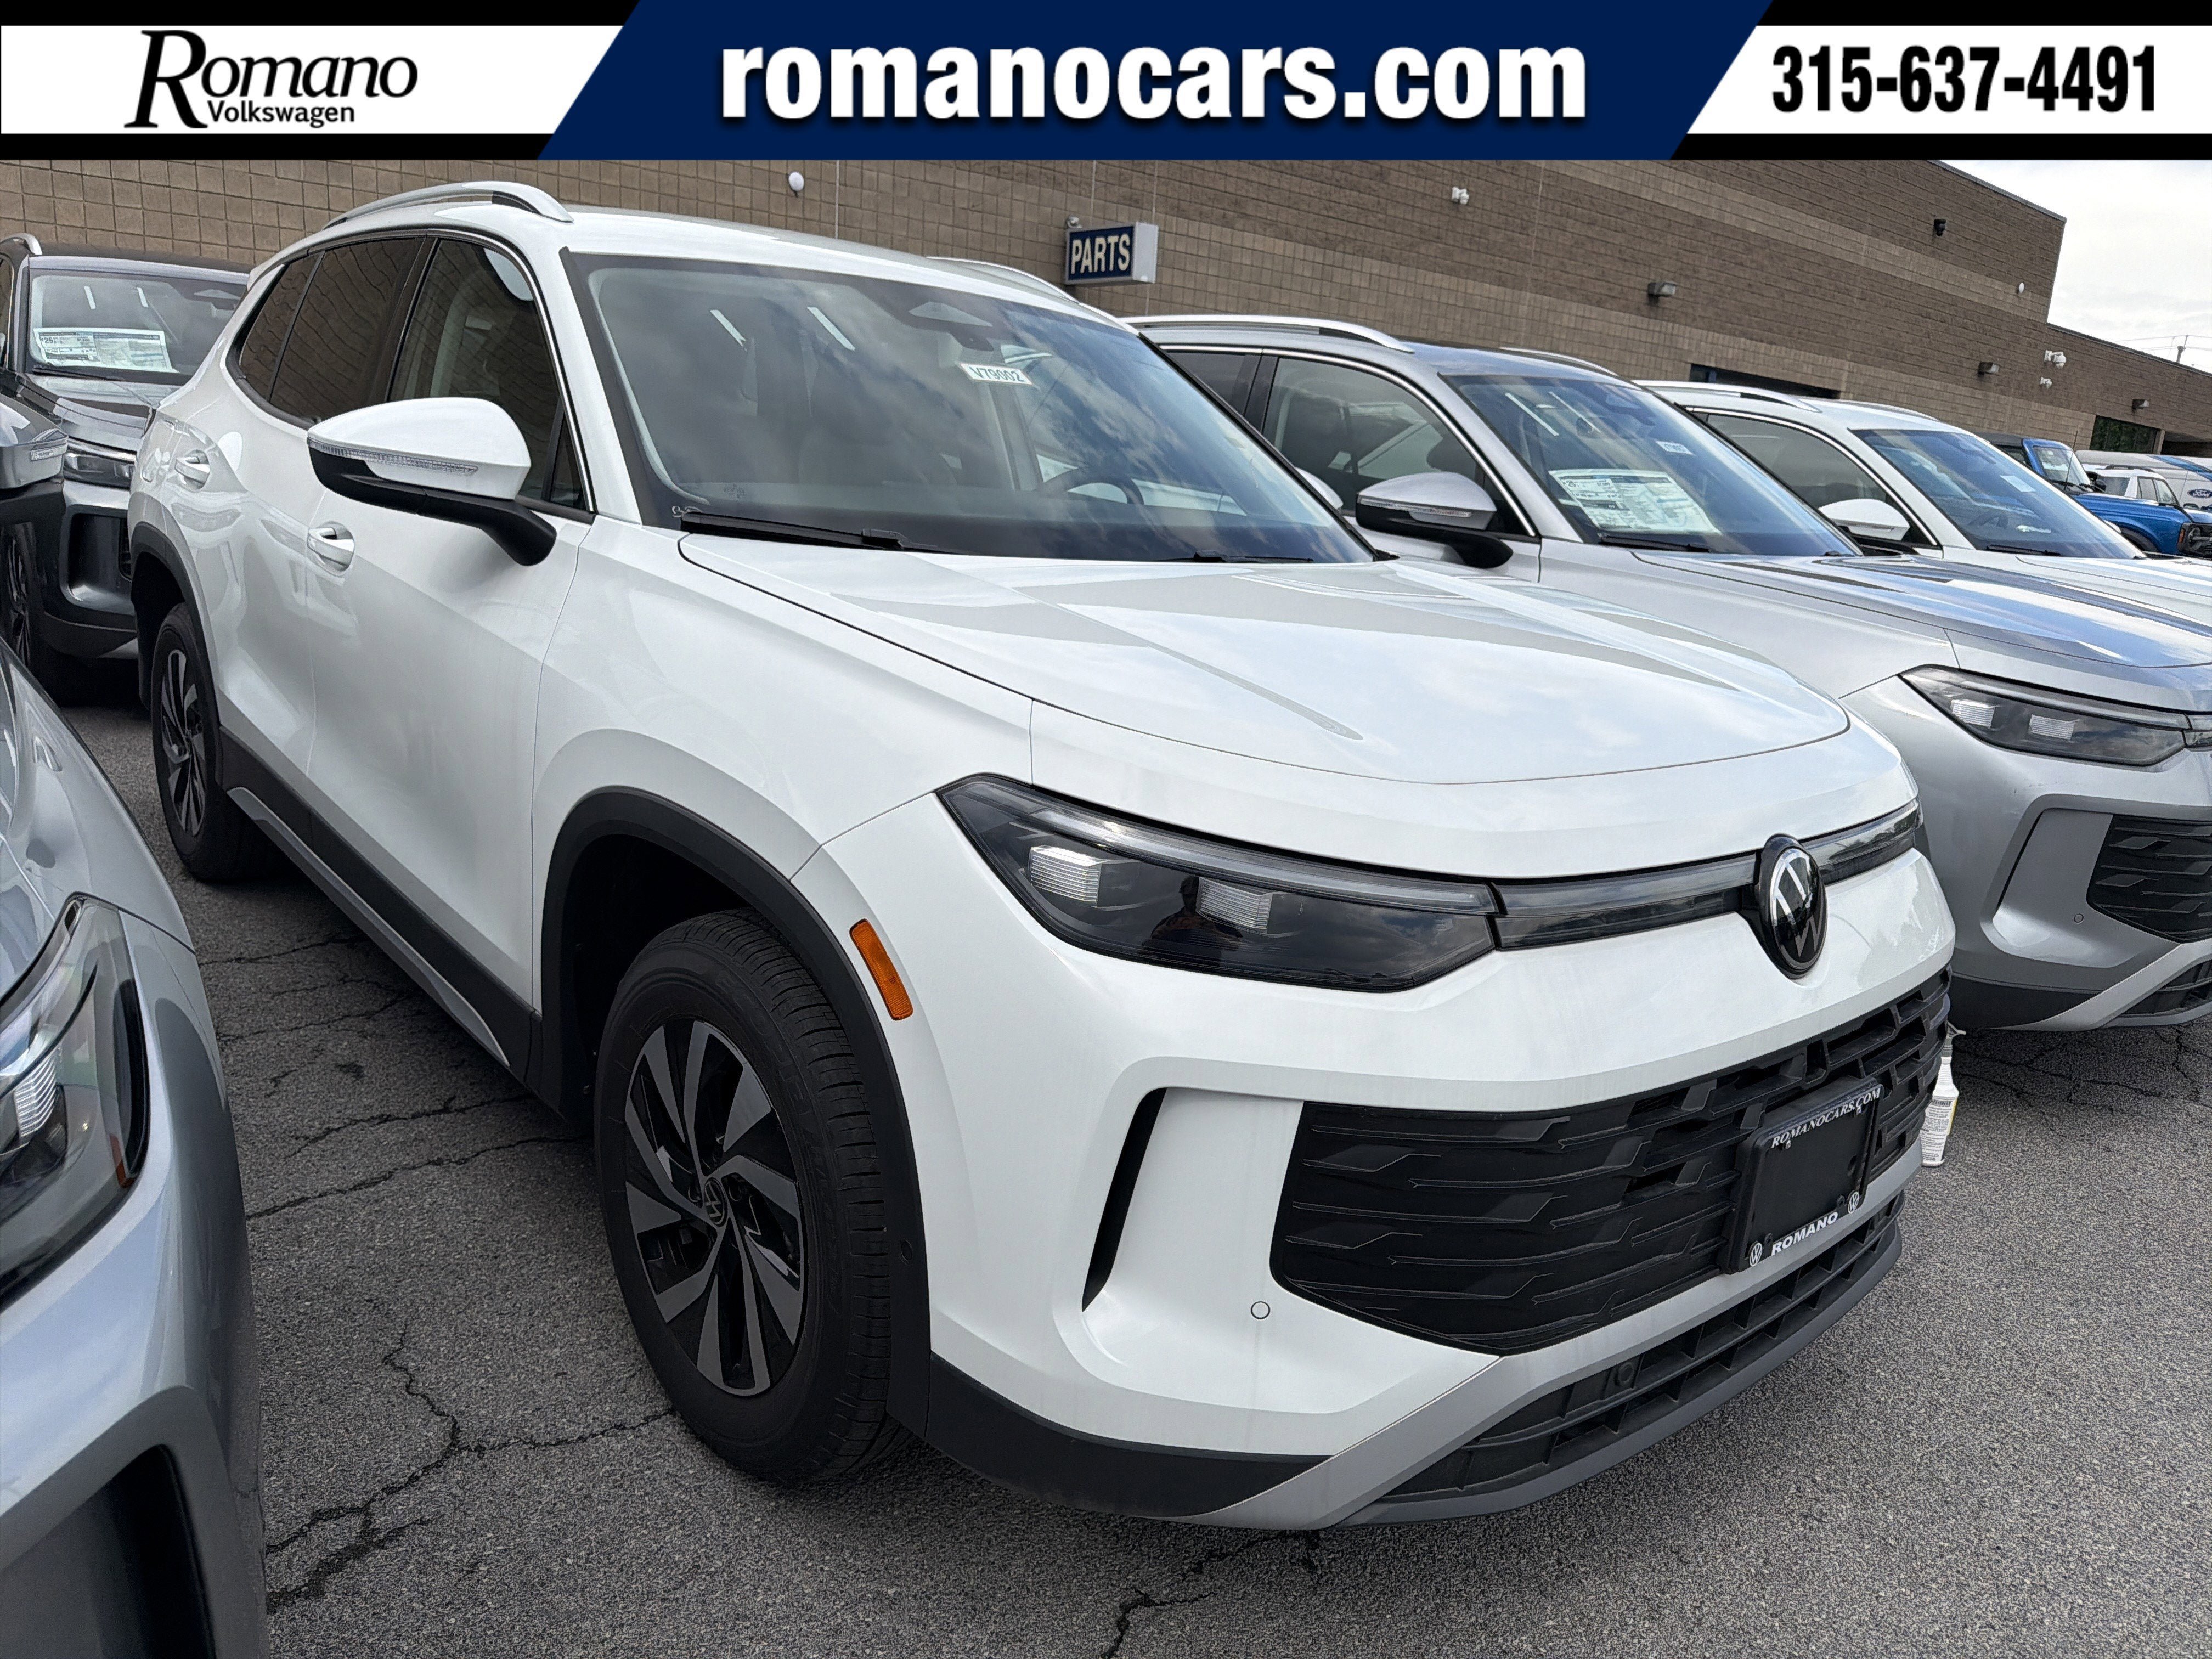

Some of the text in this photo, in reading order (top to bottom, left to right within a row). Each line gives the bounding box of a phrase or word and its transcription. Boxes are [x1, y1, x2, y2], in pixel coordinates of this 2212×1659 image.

[1071, 233, 1130, 275] PARTS
[968, 366, 1025, 382] V79002
[1770, 1087, 1881, 1149] ROMANOCARS.COM
[1771, 1211, 1838, 1256] ROMANO
